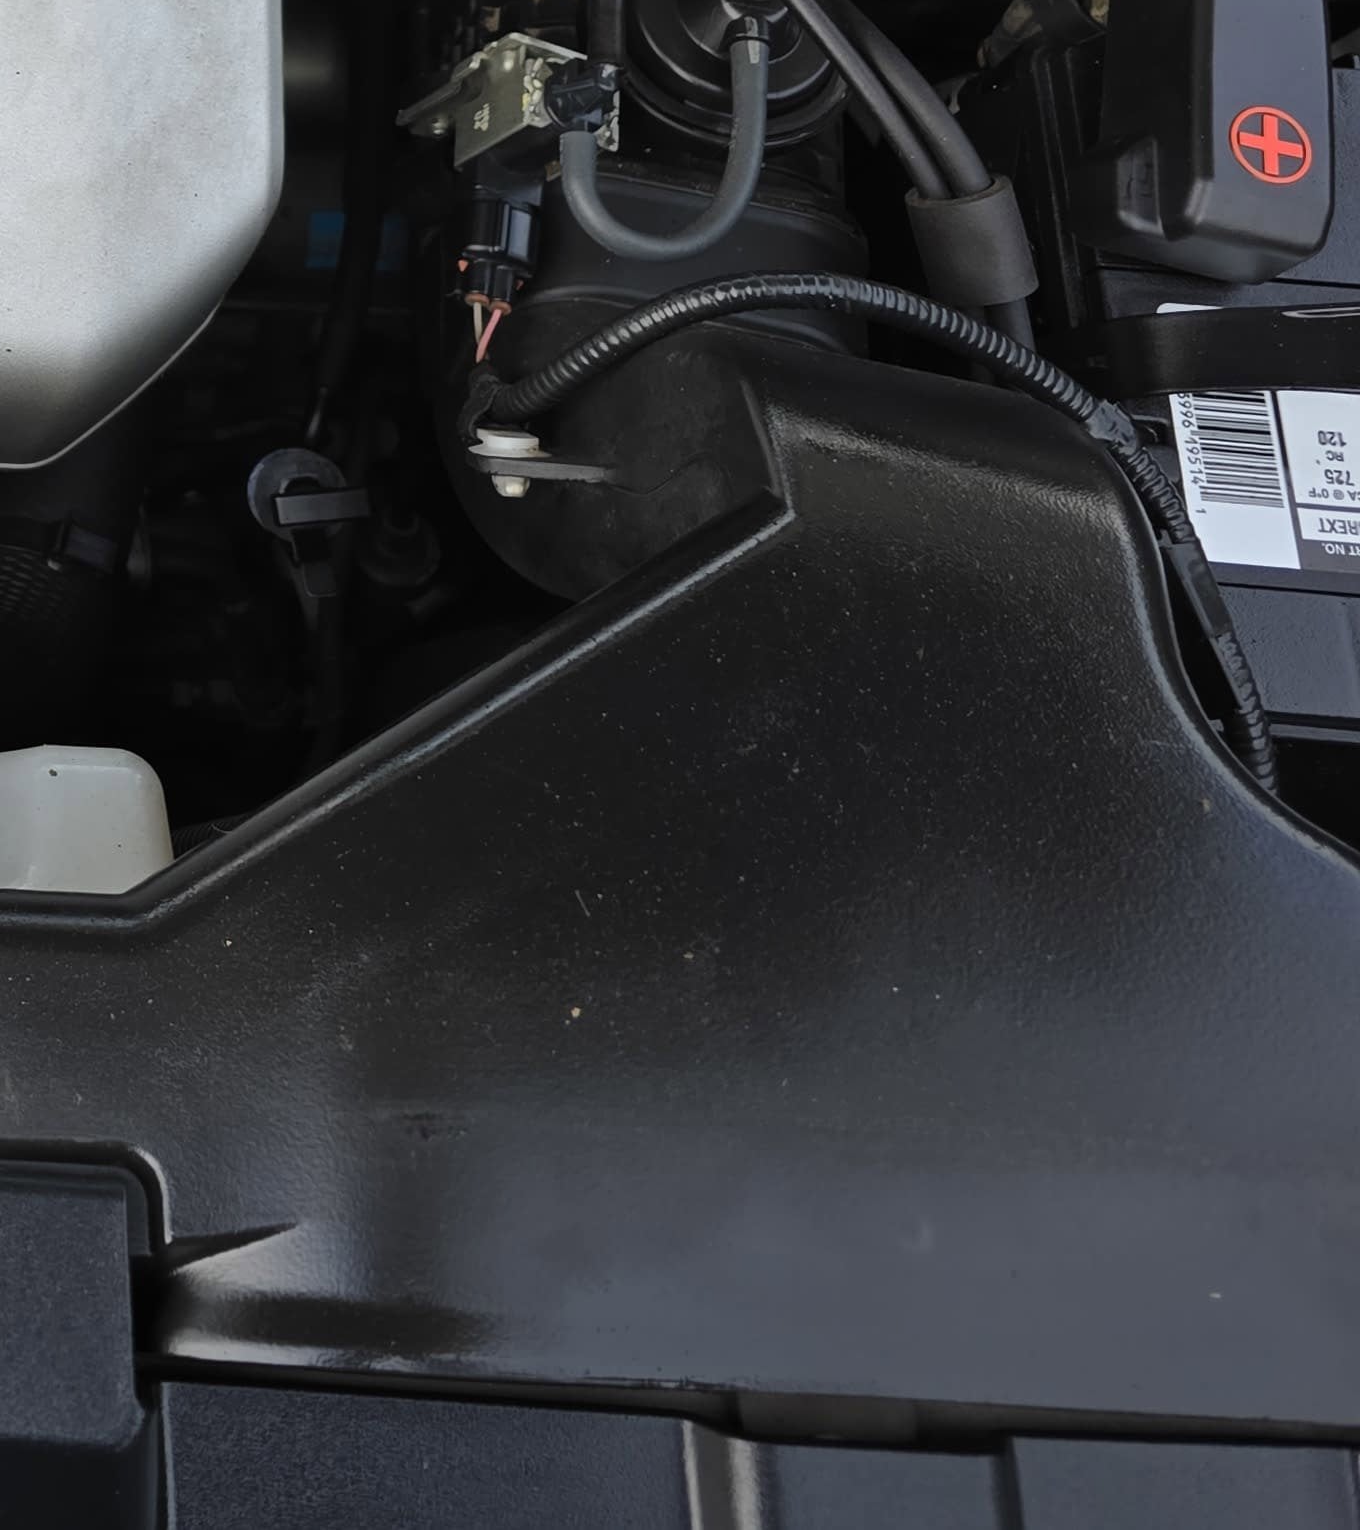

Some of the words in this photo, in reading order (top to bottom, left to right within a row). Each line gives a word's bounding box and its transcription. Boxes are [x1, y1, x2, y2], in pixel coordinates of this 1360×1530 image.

[1318, 430, 1347, 447] 120
[1325, 450, 1344, 462] RC
[1324, 469, 1355, 486] 725
[1318, 517, 1360, 535] REXT
[1321, 542, 1345, 555] NO.
